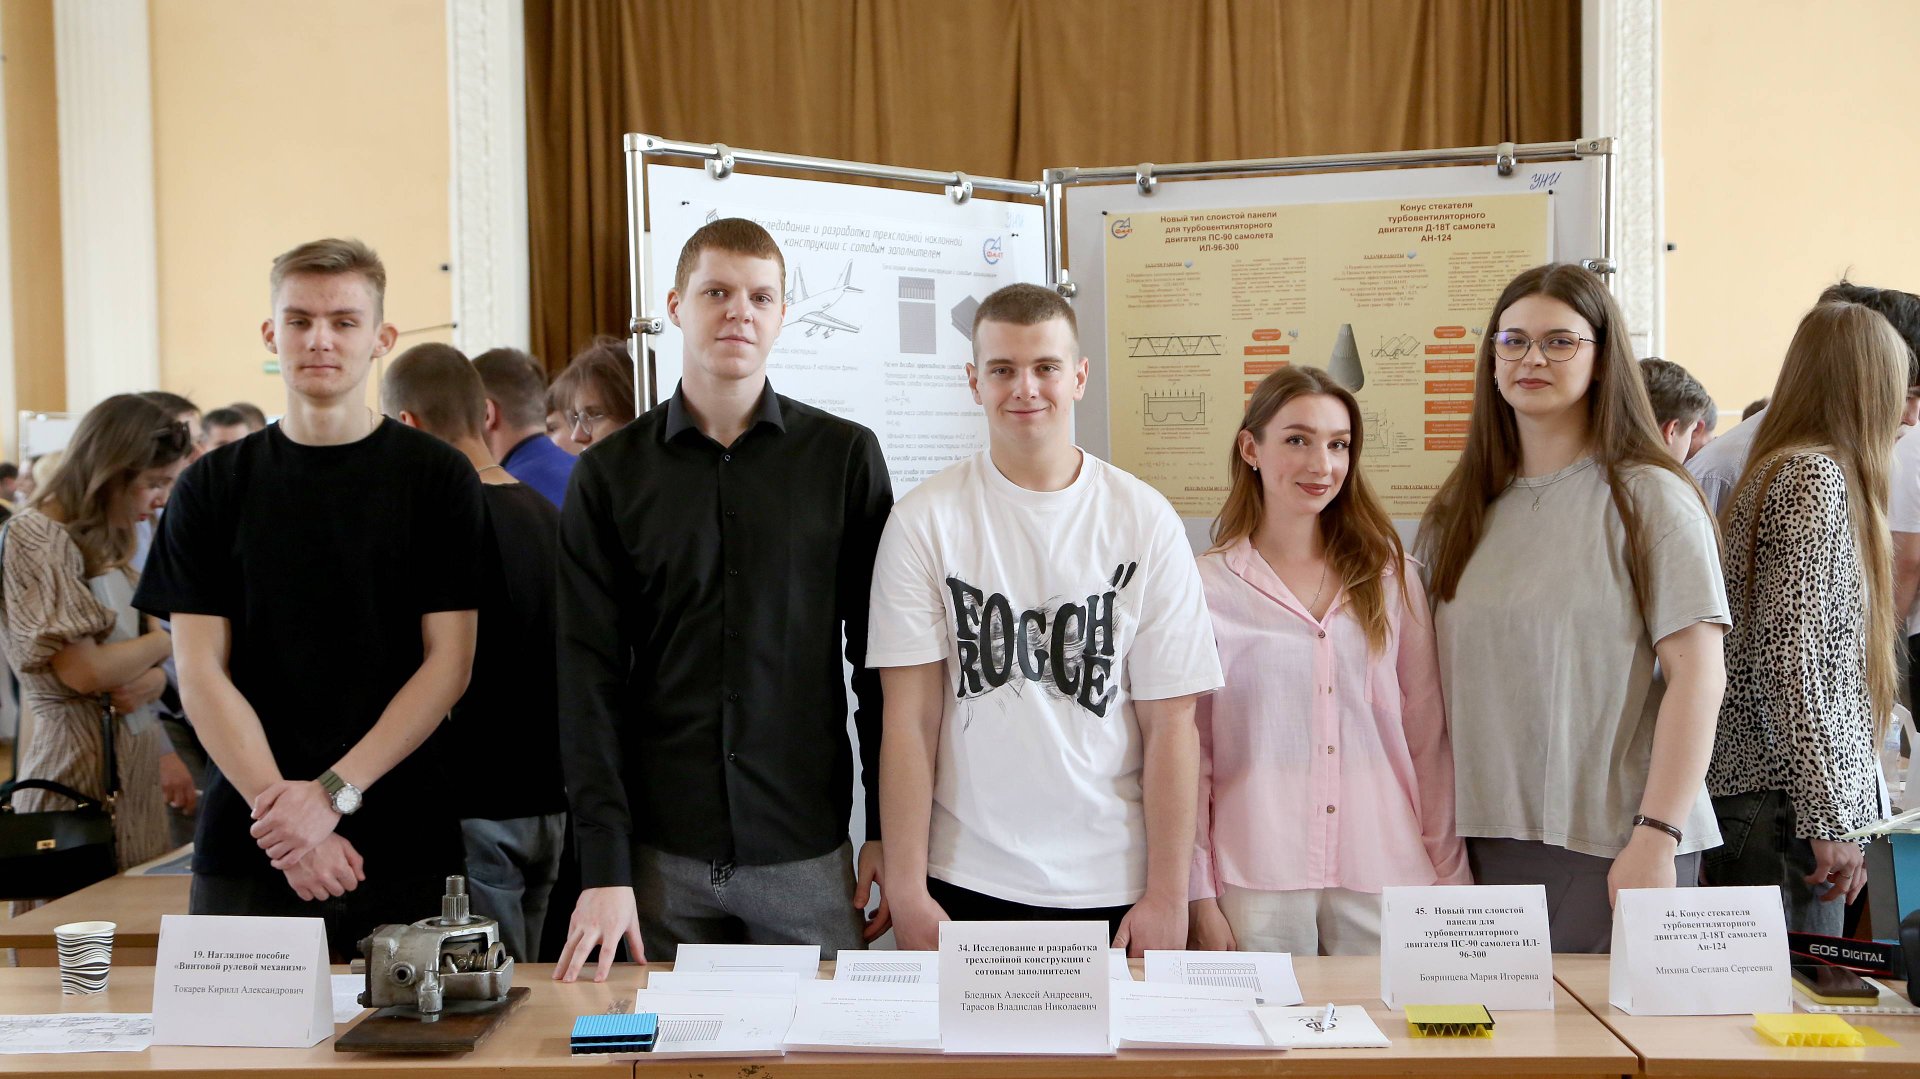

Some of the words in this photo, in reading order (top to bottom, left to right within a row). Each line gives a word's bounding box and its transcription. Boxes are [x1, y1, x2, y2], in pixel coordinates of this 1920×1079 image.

[1400, 203, 1426, 212] Конус
[1428, 201, 1473, 210] стекателя
[1160, 214, 1188, 223] Новый
[1190, 214, 1204, 222] тип
[1206, 212, 1245, 221] слоистой
[1247, 210, 1277, 219] панели
[1388, 211, 1486, 223] турбовентиляторного
[1165, 225, 1181, 234] для
[1182, 222, 1273, 233] турбовентиляторного
[1378, 225, 1424, 234] двигателя
[1425, 223, 1450, 232] Д-18Т
[1452, 222, 1496, 230] самолета
[813, 225, 819, 234] и
[821, 224, 870, 238] разработка
[872, 229, 923, 243] трехслойной
[924, 234, 963, 247] наклонной
[1165, 235, 1207, 244] двигателя
[1208, 233, 1233, 241] ПС-90
[1234, 232, 1273, 240] самолета
[1421, 234, 1452, 242] АН-124
[783, 237, 840, 251] конструкции
[842, 242, 847, 251] с
[850, 242, 885, 255] сотовым
[887, 246, 941, 259] заполнителем
[1199, 243, 1240, 252] ИЛ-96-300
[1415, 907, 1427, 915] 45.
[1434, 906, 1465, 915] Новый
[1485, 906, 1524, 914] слоистой
[1665, 910, 1678, 918] 44.
[1680, 909, 1705, 919] Конус
[1707, 909, 1750, 917] стекателя
[1446, 918, 1477, 926] панели
[1479, 918, 1495, 926] для
[1662, 920, 1756, 931] турбовентиляторного
[1424, 929, 1519, 939] турбовентиляторного
[1654, 933, 1698, 941] двигателя
[1700, 931, 1725, 940] Д-18Т
[1727, 931, 1768, 939] самолета
[957, 943, 971, 952] 34.
[973, 943, 1036, 953] Исследование
[1038, 944, 1044, 952] и
[1046, 943, 1098, 953] разработка
[1404, 940, 1449, 949] двигателя
[1451, 939, 1478, 948] ПС-90
[1480, 939, 1520, 947] самолета
[1522, 938, 1540, 947] ИЛ-
[1697, 942, 1727, 951] Ан-124
[193, 950, 205, 959] 19.
[207, 950, 254, 960] Наглядное
[256, 951, 290, 960] пособие
[1459, 950, 1487, 959] 96-300
[1809, 943, 1839, 957] EOS
[1842, 948, 1886, 963] DIGITAL
[964, 955, 1022, 965] трехслойной
[1024, 955, 1084, 965] конструкции
[174, 961, 221, 971] «Винтовой
[222, 962, 258, 972] рулевой
[260, 963, 307, 972] механизм»
[975, 967, 1015, 976] сотовым
[1017, 967, 1081, 976] заполнителем
[1655, 966, 1689, 975] Михина
[1691, 965, 1729, 974] Светлана
[1730, 964, 1773, 974] Сергеевна
[1419, 973, 1468, 983] Бояринцева
[1470, 972, 1498, 982] Мария
[1499, 972, 1539, 982] Игоревна
[173, 984, 206, 995] Токарев
[208, 985, 239, 995] Кирилл
[241, 985, 304, 996] Александрович
[964, 990, 1001, 1000] Бледных
[1004, 990, 1040, 999] Алексей
[1042, 990, 1093, 1001] Андреевич,
[960, 1002, 995, 1013] Тарасов
[997, 1002, 1043, 1011] Владислав
[1045, 1002, 1097, 1011] Николаевич
